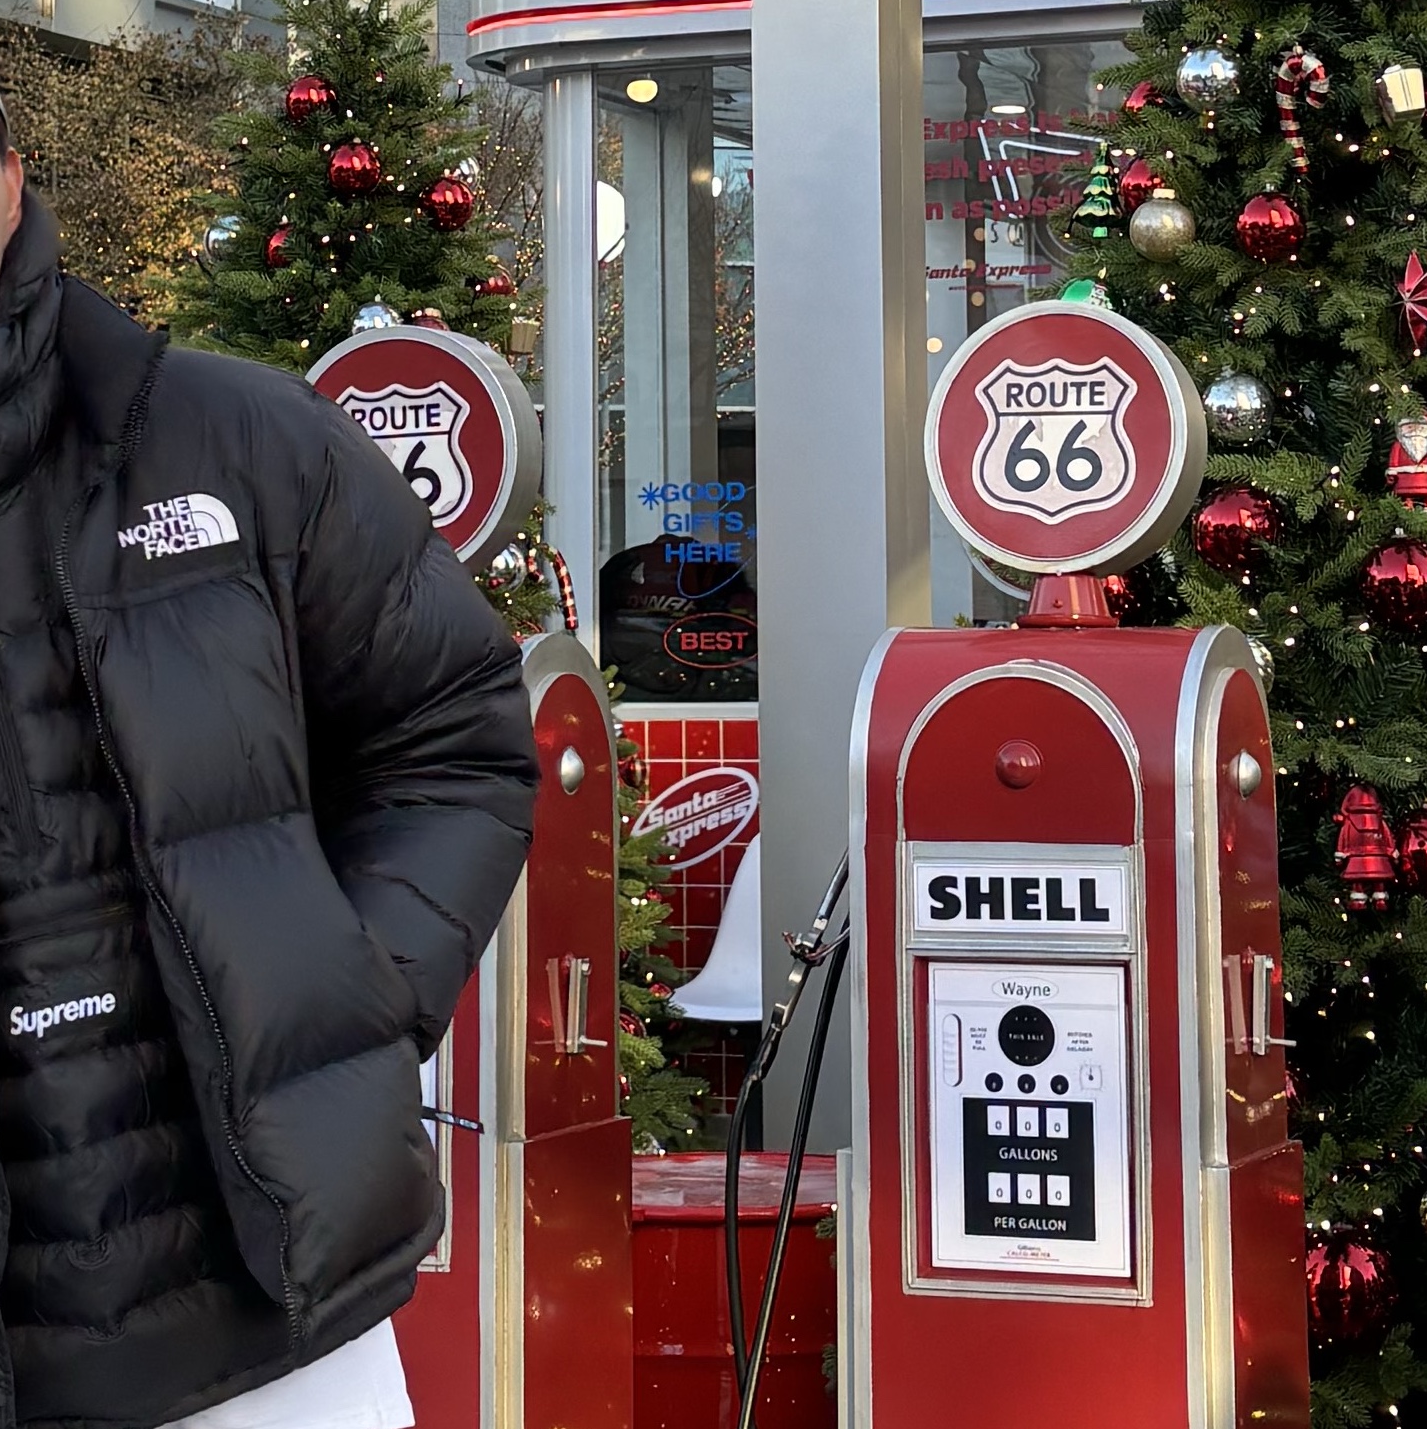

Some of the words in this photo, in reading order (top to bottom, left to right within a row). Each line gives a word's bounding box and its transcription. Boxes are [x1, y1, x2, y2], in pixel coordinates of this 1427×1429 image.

[1005, 380, 1106, 409] ROUTE
[1004, 419, 1104, 493] 66
[402, 439, 442, 507] 6
[660, 481, 746, 503] GOOD
[143, 496, 191, 521] THE
[663, 511, 744, 533] GIFTS
[117, 513, 195, 548] NORTH
[143, 531, 200, 560] FACE
[665, 542, 743, 564] HERE
[681, 631, 749, 651] BEST
[648, 791, 723, 826] Santa
[661, 801, 752, 848] xpress
[927, 874, 1111, 923] SHELL
[1001, 982, 1051, 1000] Wayne
[10, 991, 117, 1037] Supreme
[999, 1146, 1058, 1162] GALLONS
[994, 1216, 1016, 1229] PER
[1018, 1217, 1067, 1232] GALLON
